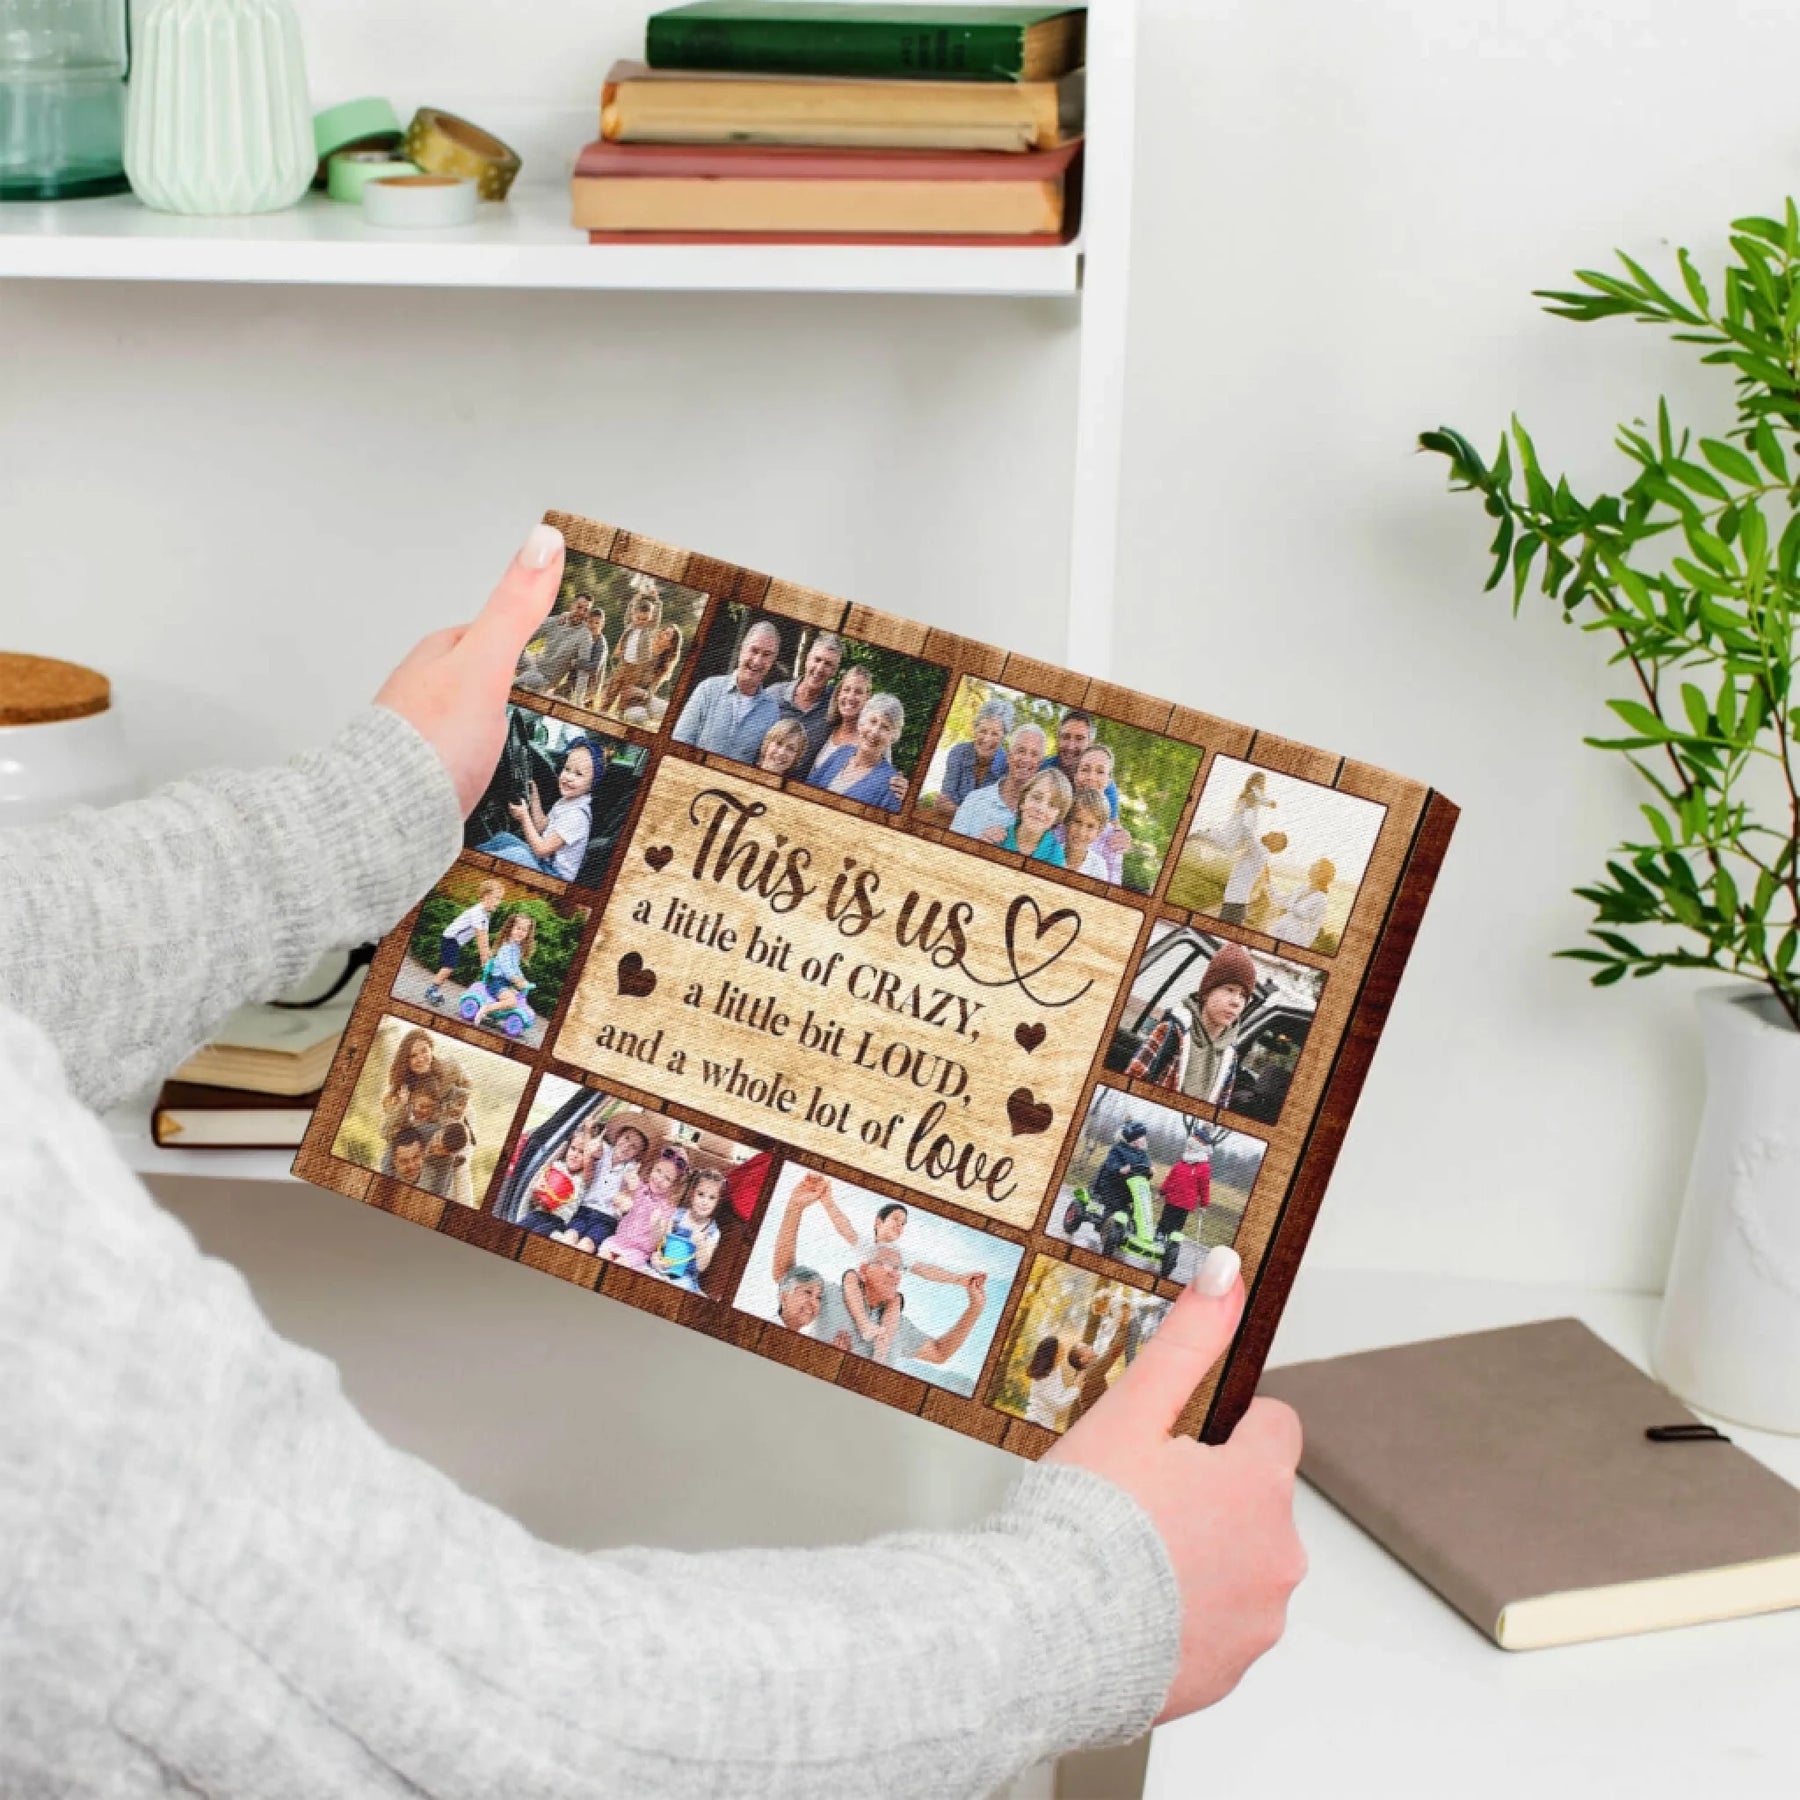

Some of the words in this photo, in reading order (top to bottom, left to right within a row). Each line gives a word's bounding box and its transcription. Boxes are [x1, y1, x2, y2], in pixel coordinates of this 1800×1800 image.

[689, 788, 818, 913] This
[826, 857, 885, 937] is
[897, 890, 974, 969] us
[632, 900, 651, 924] a
[662, 897, 738, 952] little
[745, 925, 792, 973] bit
[801, 952, 845, 987] of
[848, 963, 985, 1041] CRAZY,
[683, 983, 704, 1008] a
[712, 980, 790, 1036] little
[799, 1010, 845, 1057] bit
[852, 1031, 972, 1107] LOUD,
[595, 1023, 664, 1065] and
[666, 1050, 687, 1075] a
[701, 1058, 797, 1114] whole
[804, 1086, 850, 1134] lot
[860, 1113, 904, 1150] of
[906, 1100, 1017, 1203] love
